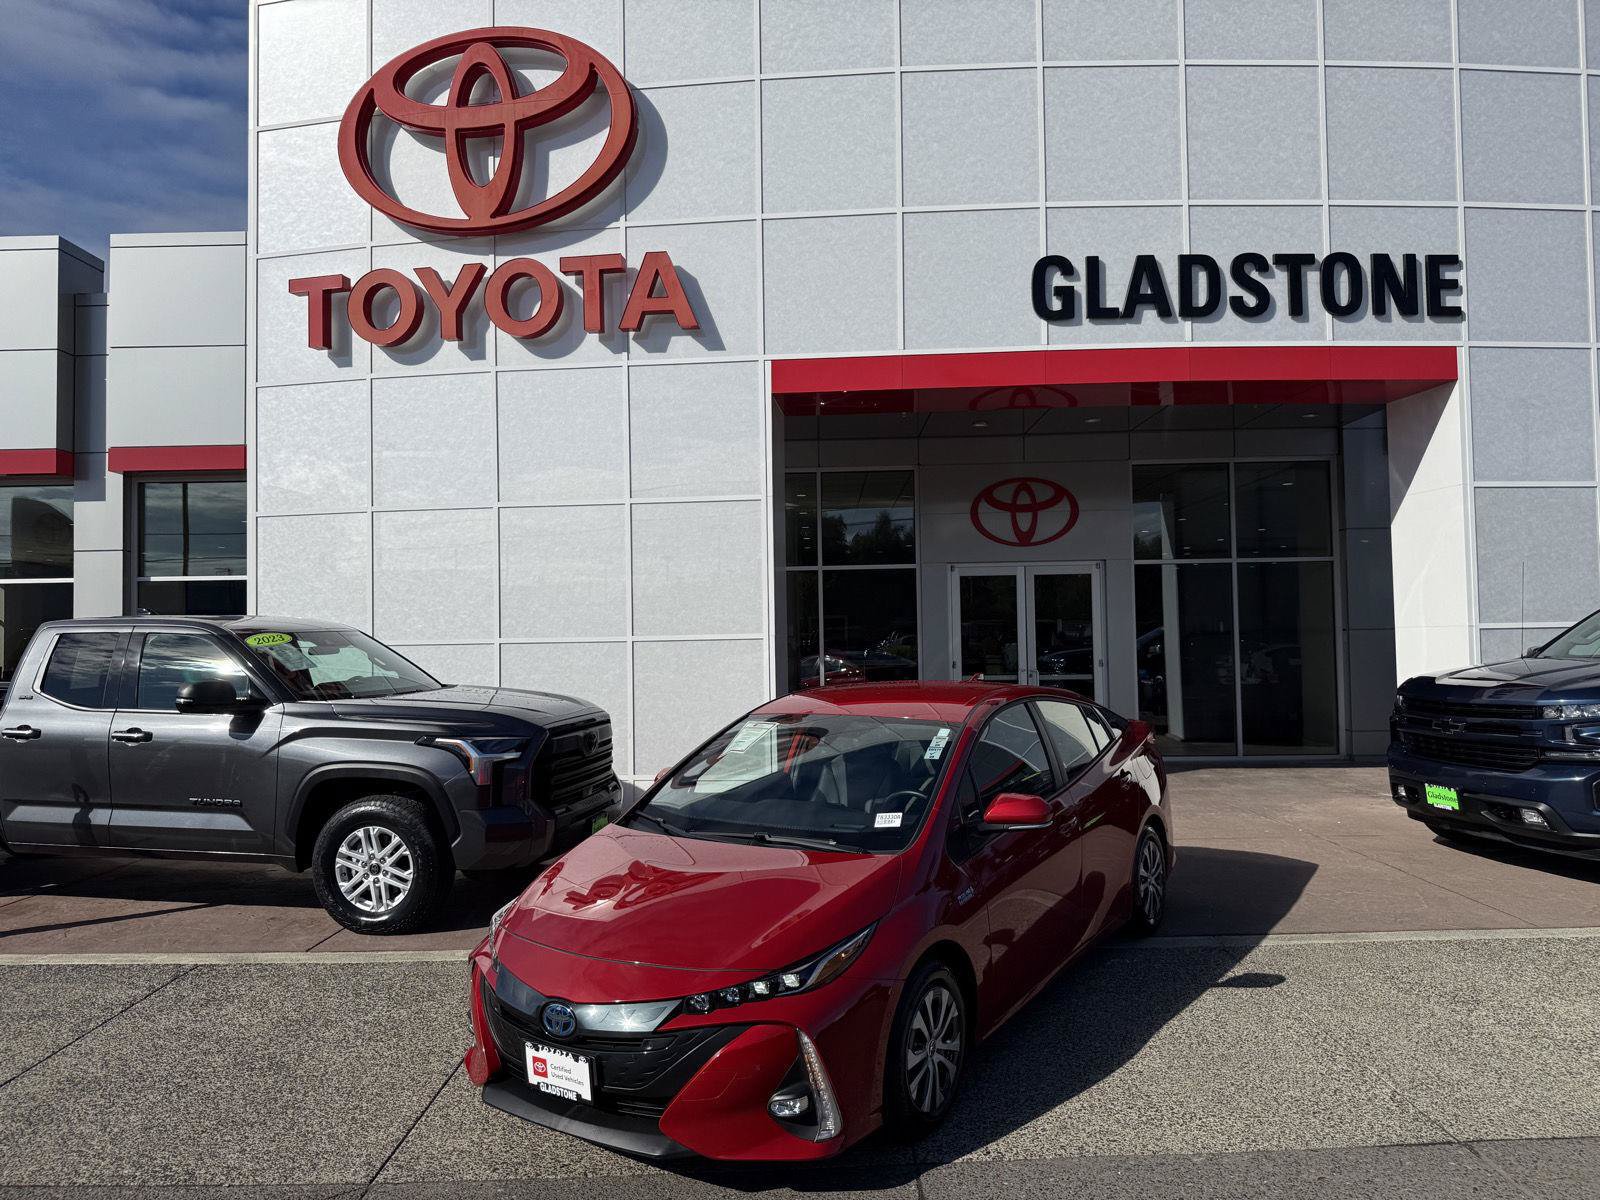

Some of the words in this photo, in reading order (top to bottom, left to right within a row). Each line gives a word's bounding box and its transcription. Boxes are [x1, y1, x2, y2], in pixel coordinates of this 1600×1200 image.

[1031, 251, 1465, 323] GLADSTONE
[288, 250, 700, 352] TOYOTA
[254, 634, 285, 646] 2023
[189, 797, 241, 806] TUNDRA
[537, 1044, 573, 1059] TOYOTA
[549, 1063, 572, 1075] Certified
[550, 1071, 564, 1081] Used
[564, 1075, 585, 1087] Vehicles
[539, 1083, 578, 1101] GLADSTONE
